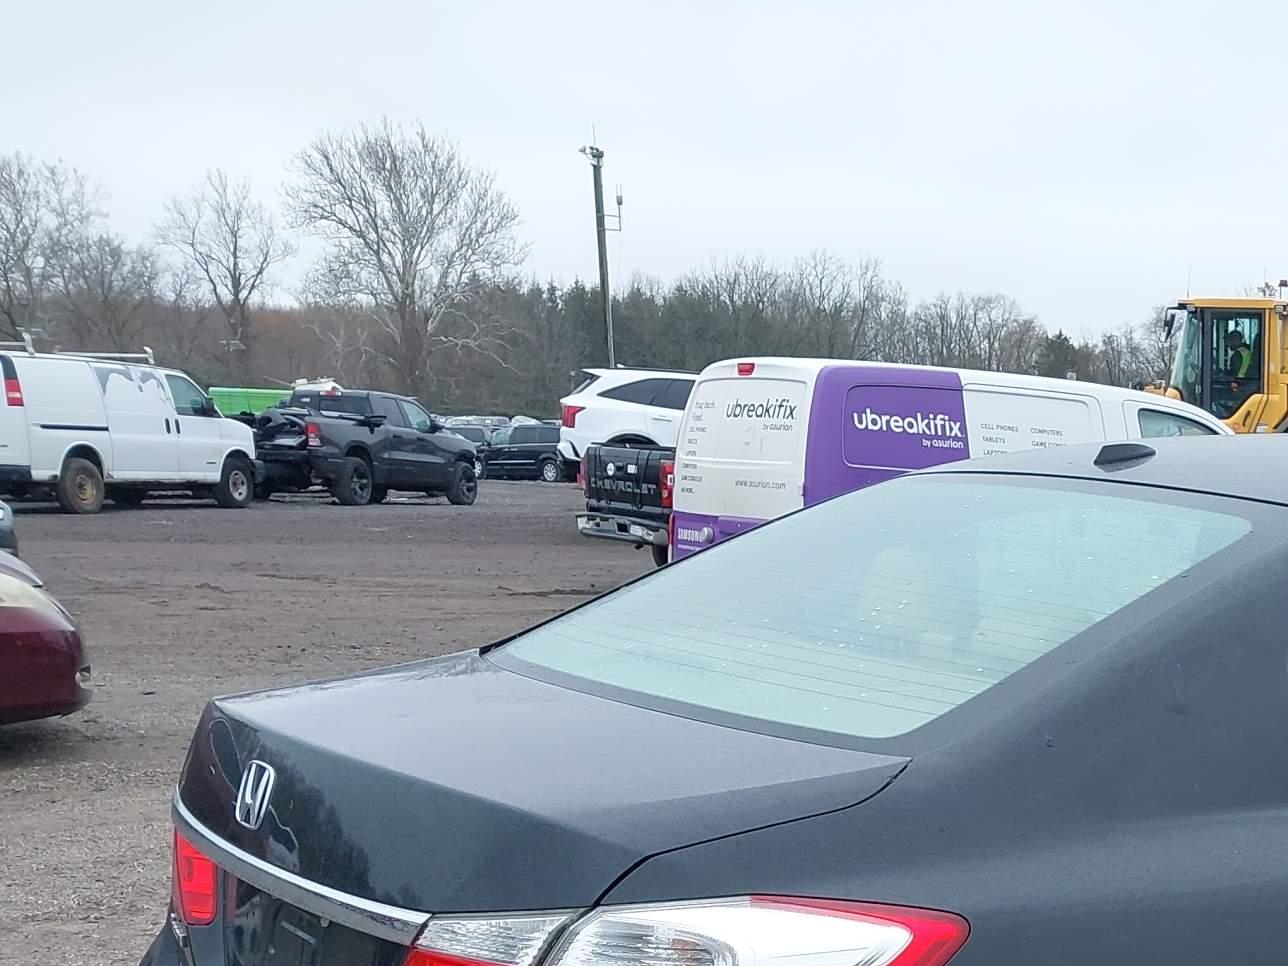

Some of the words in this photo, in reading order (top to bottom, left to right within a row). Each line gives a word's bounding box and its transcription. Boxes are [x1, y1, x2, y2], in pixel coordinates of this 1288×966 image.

[726, 398, 797, 420] ubreakifix
[762, 423, 769, 431] by
[769, 422, 793, 431] asurion
[853, 408, 962, 437] ubreakifix
[980, 423, 995, 431] CELL
[996, 424, 1019, 432] PHONES
[1030, 427, 1063, 436] COMPUTERS
[922, 438, 931, 448] by
[932, 438, 964, 448] asurion
[982, 435, 1006, 444] TABLETS
[1031, 440, 1047, 448] GAME
[590, 477, 657, 495] CHEVROLET
[735, 480, 786, 490] www.asurion.com
